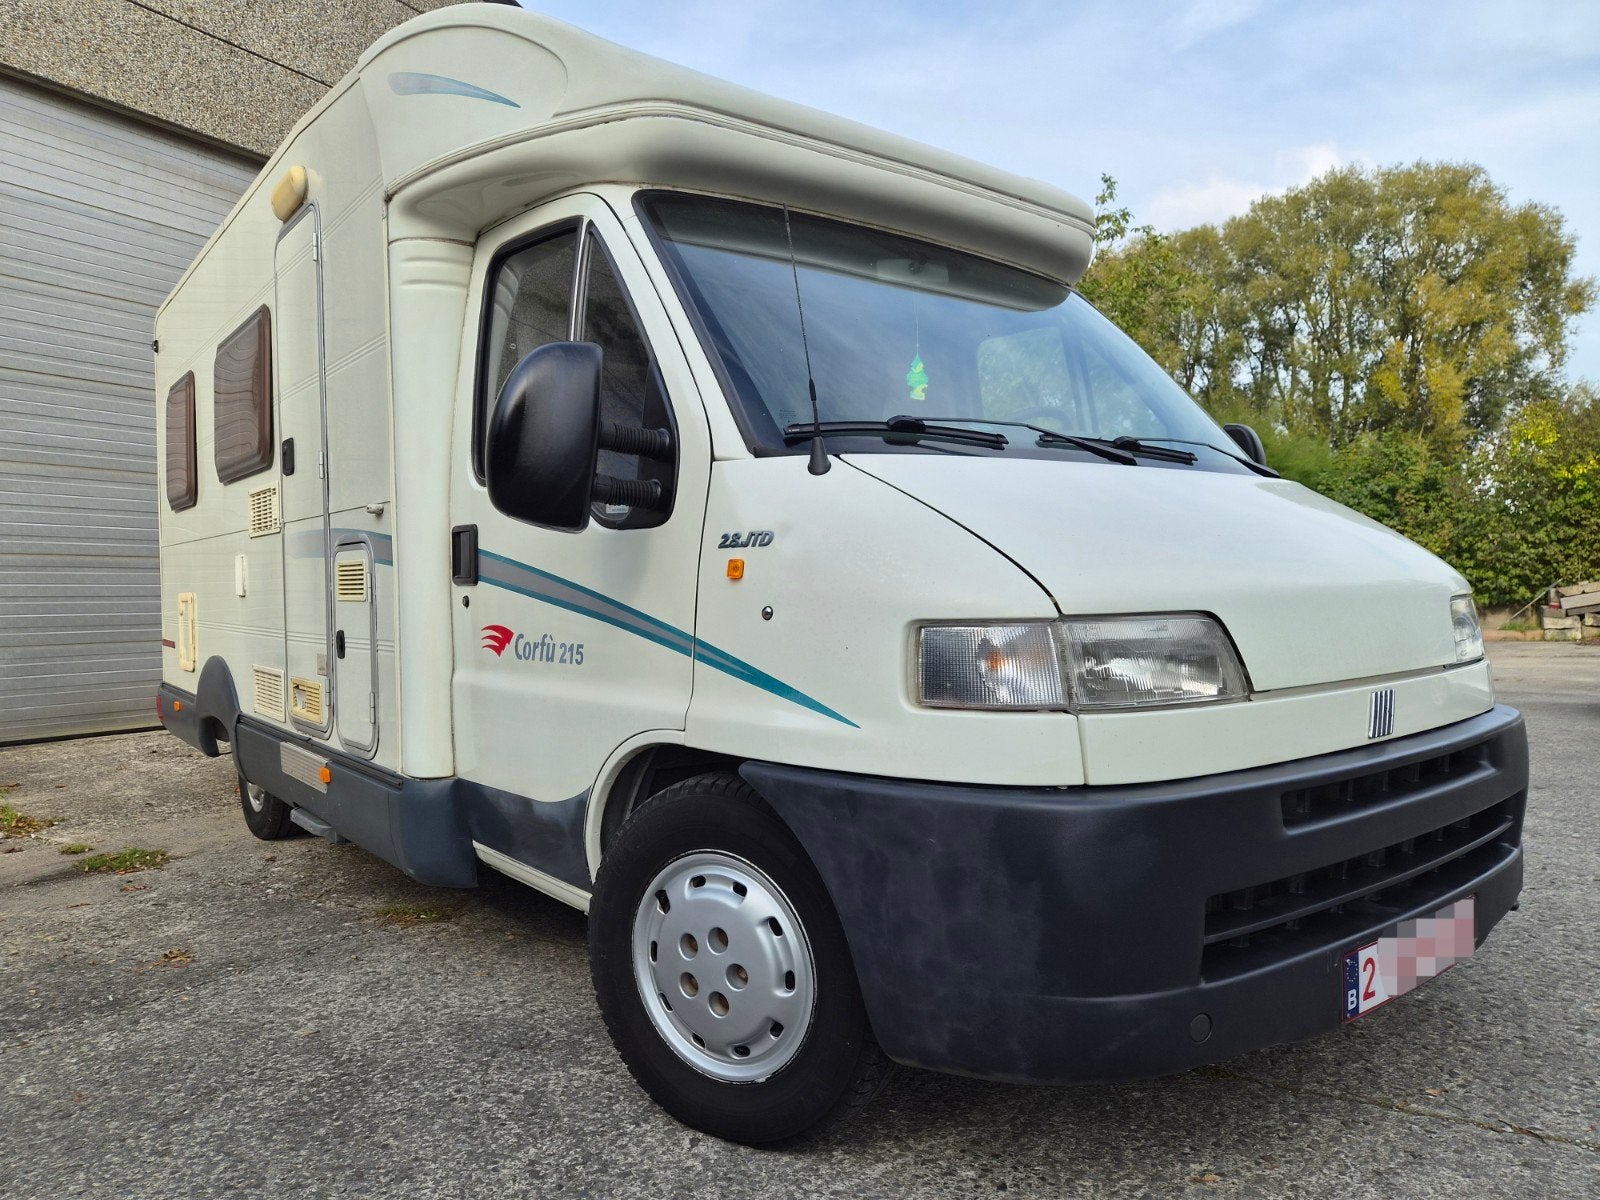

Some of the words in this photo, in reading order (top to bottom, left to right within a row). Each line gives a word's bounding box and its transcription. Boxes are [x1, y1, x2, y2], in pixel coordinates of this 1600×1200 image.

[515, 633, 556, 662] Corfù
[559, 643, 584, 665] 215
[1347, 988, 1357, 1011] B
